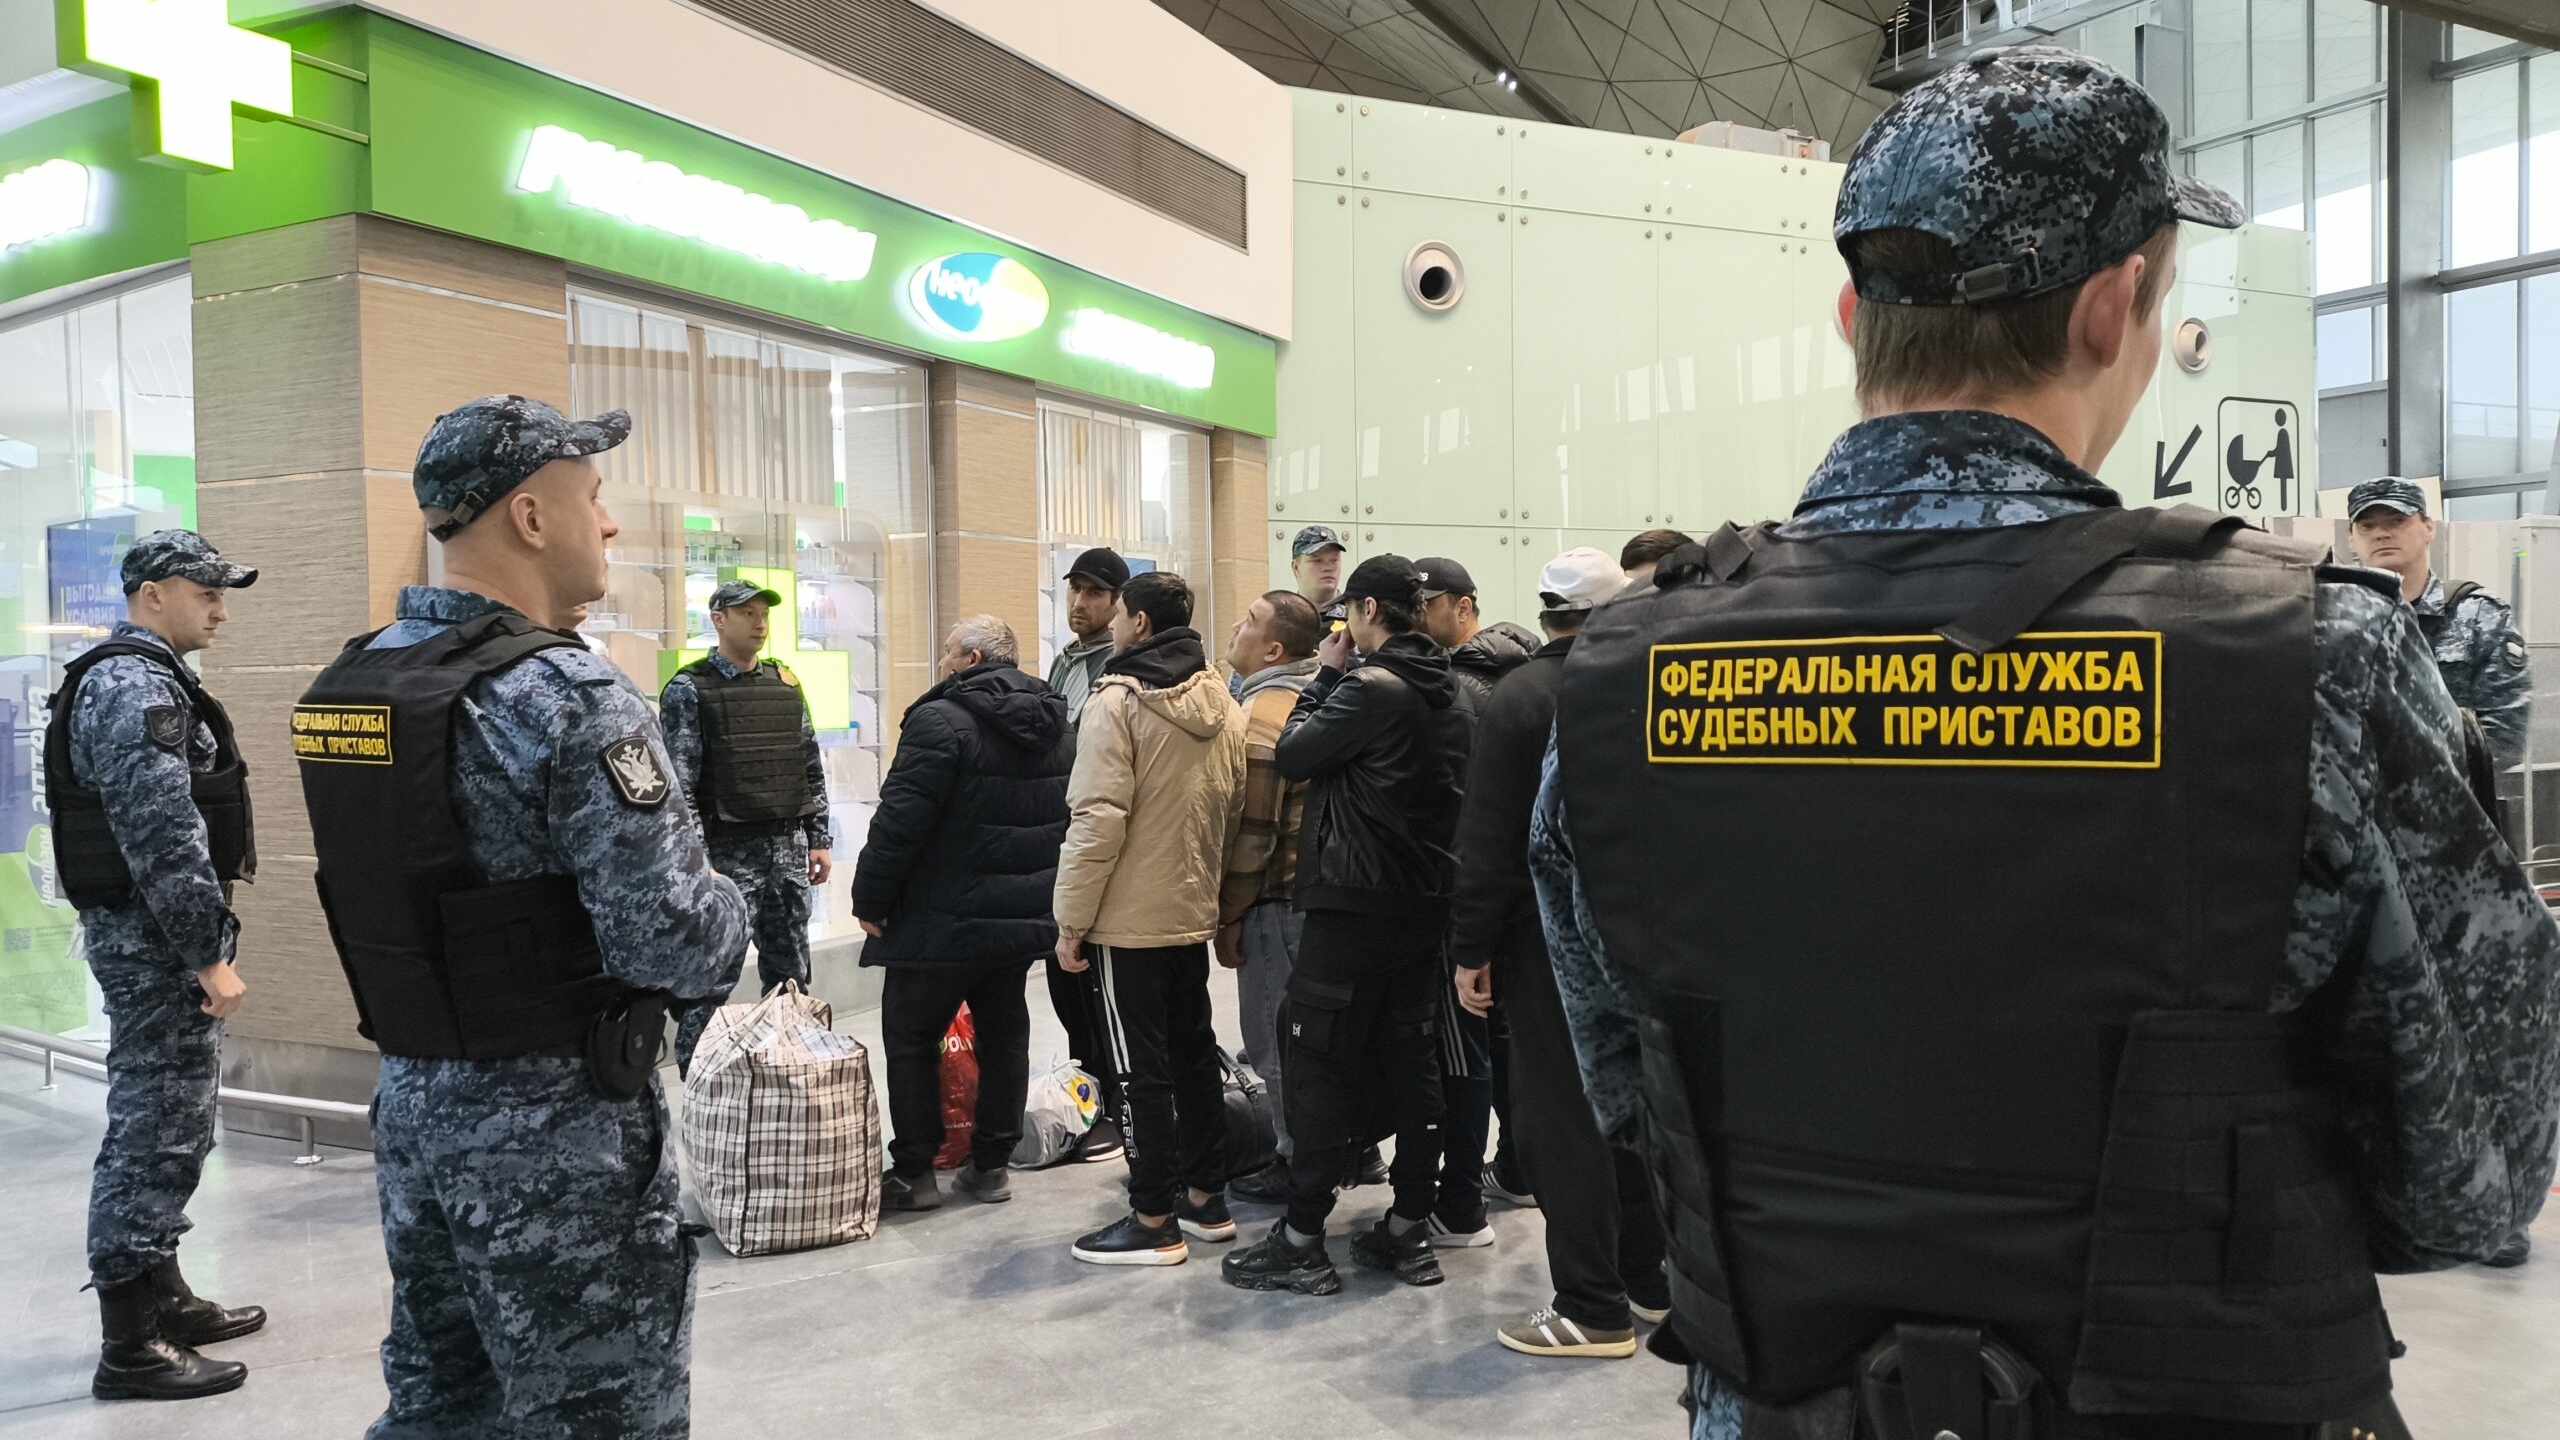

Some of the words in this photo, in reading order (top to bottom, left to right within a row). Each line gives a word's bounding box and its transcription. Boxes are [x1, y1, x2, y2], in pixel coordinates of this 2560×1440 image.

[66, 606, 116, 626] УСЛОВИЯ
[1660, 653, 1936, 702] ФЕДЕРАЛЬНАЯ
[1951, 651, 2144, 694] СЛУЖБА
[341, 714, 385, 732] СЛУЖБА
[1658, 706, 1857, 751] СУДЕБНЫХ
[1884, 706, 2142, 748] ПРИСТАВОВ
[292, 734, 325, 753] ДЕБНЫХ
[328, 736, 386, 756] ПРИСТАВОВ
